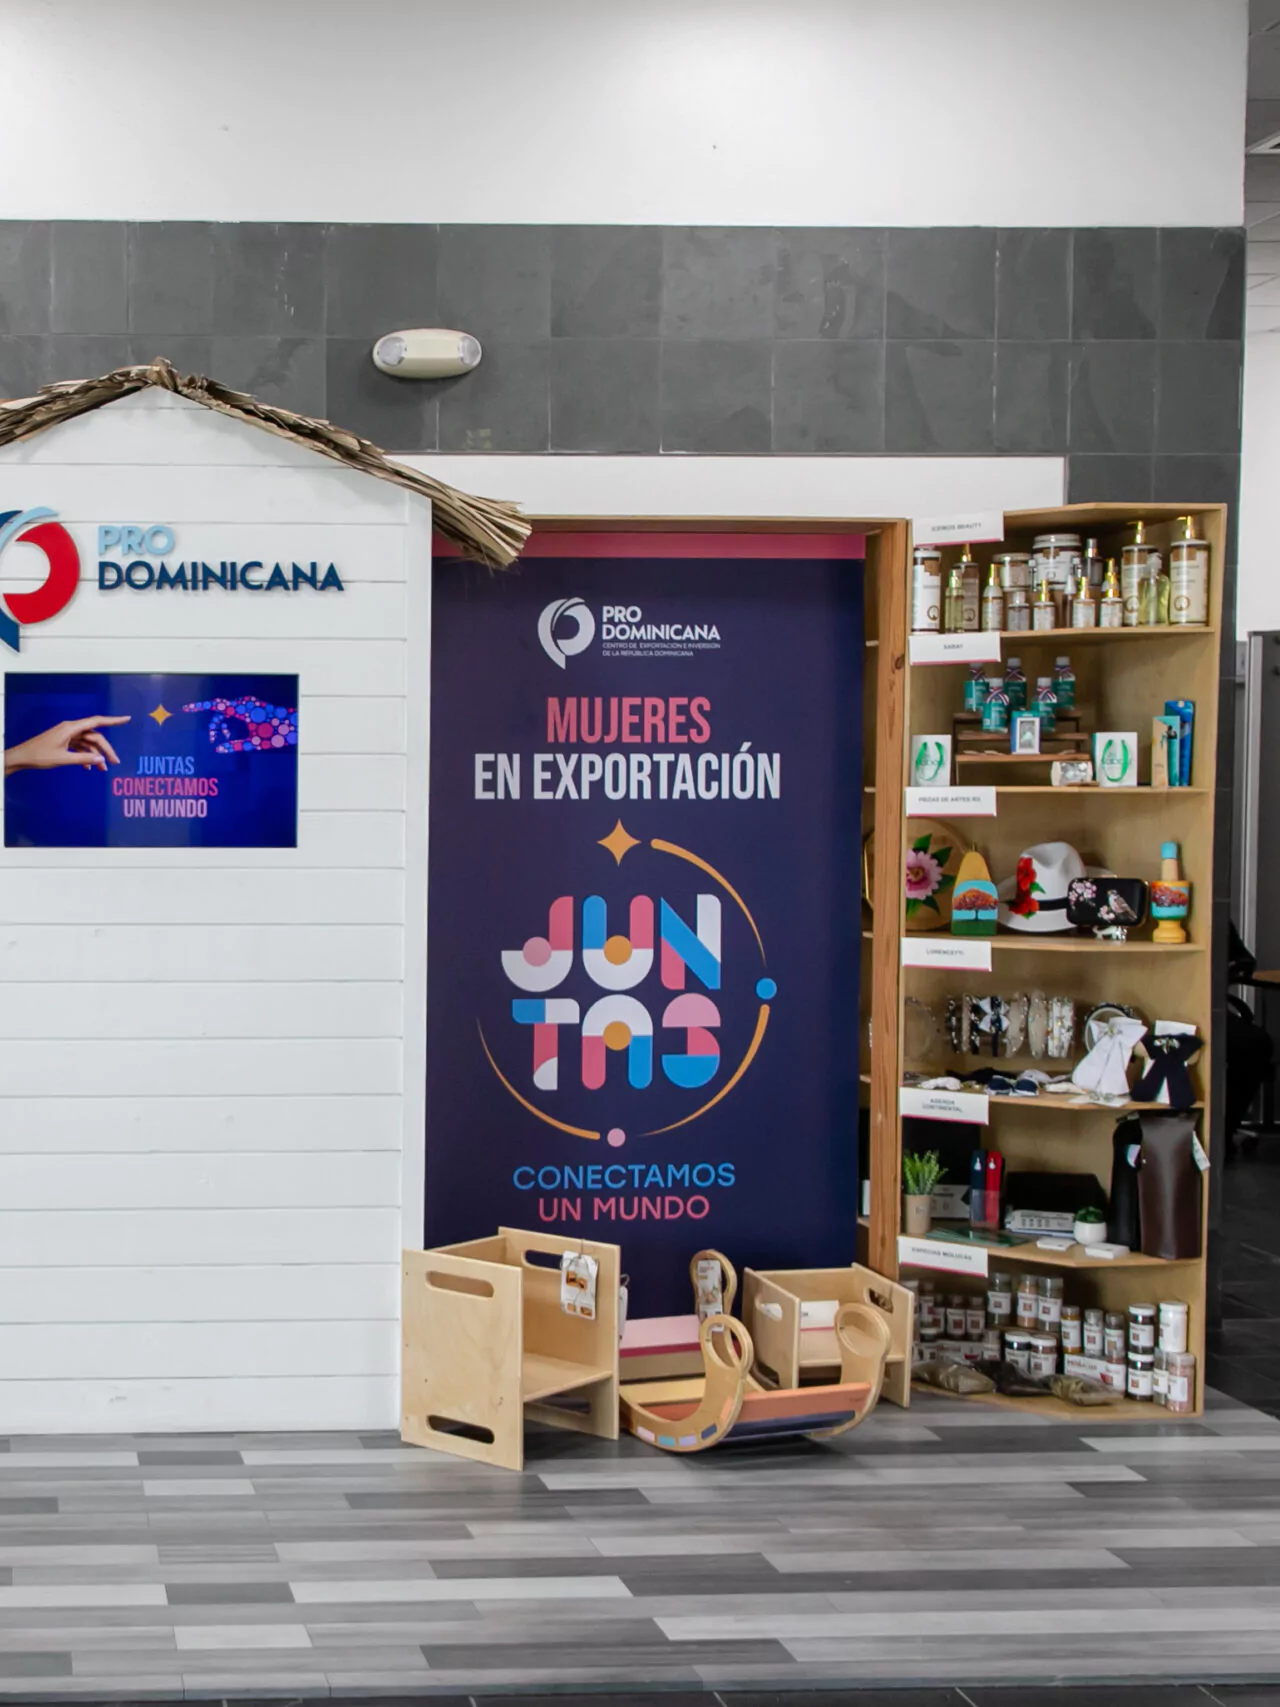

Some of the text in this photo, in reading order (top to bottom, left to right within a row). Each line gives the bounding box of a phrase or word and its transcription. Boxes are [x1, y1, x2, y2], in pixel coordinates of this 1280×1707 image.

[97, 525, 175, 555] PRO
[97, 560, 344, 591] DOMINICANA
[602, 605, 642, 623] PRO
[602, 624, 721, 641] DOMINICANA
[547, 697, 712, 744] MUJERES
[136, 756, 195, 775] JUNTAS
[474, 742, 781, 800] EN EXPORTACIÓN
[112, 778, 218, 797] CONECTAMOS
[123, 799, 208, 818] UN MUNDO
[512, 1162, 736, 1191] CONECTAMOS
[538, 1194, 710, 1221] UN MUNDO
